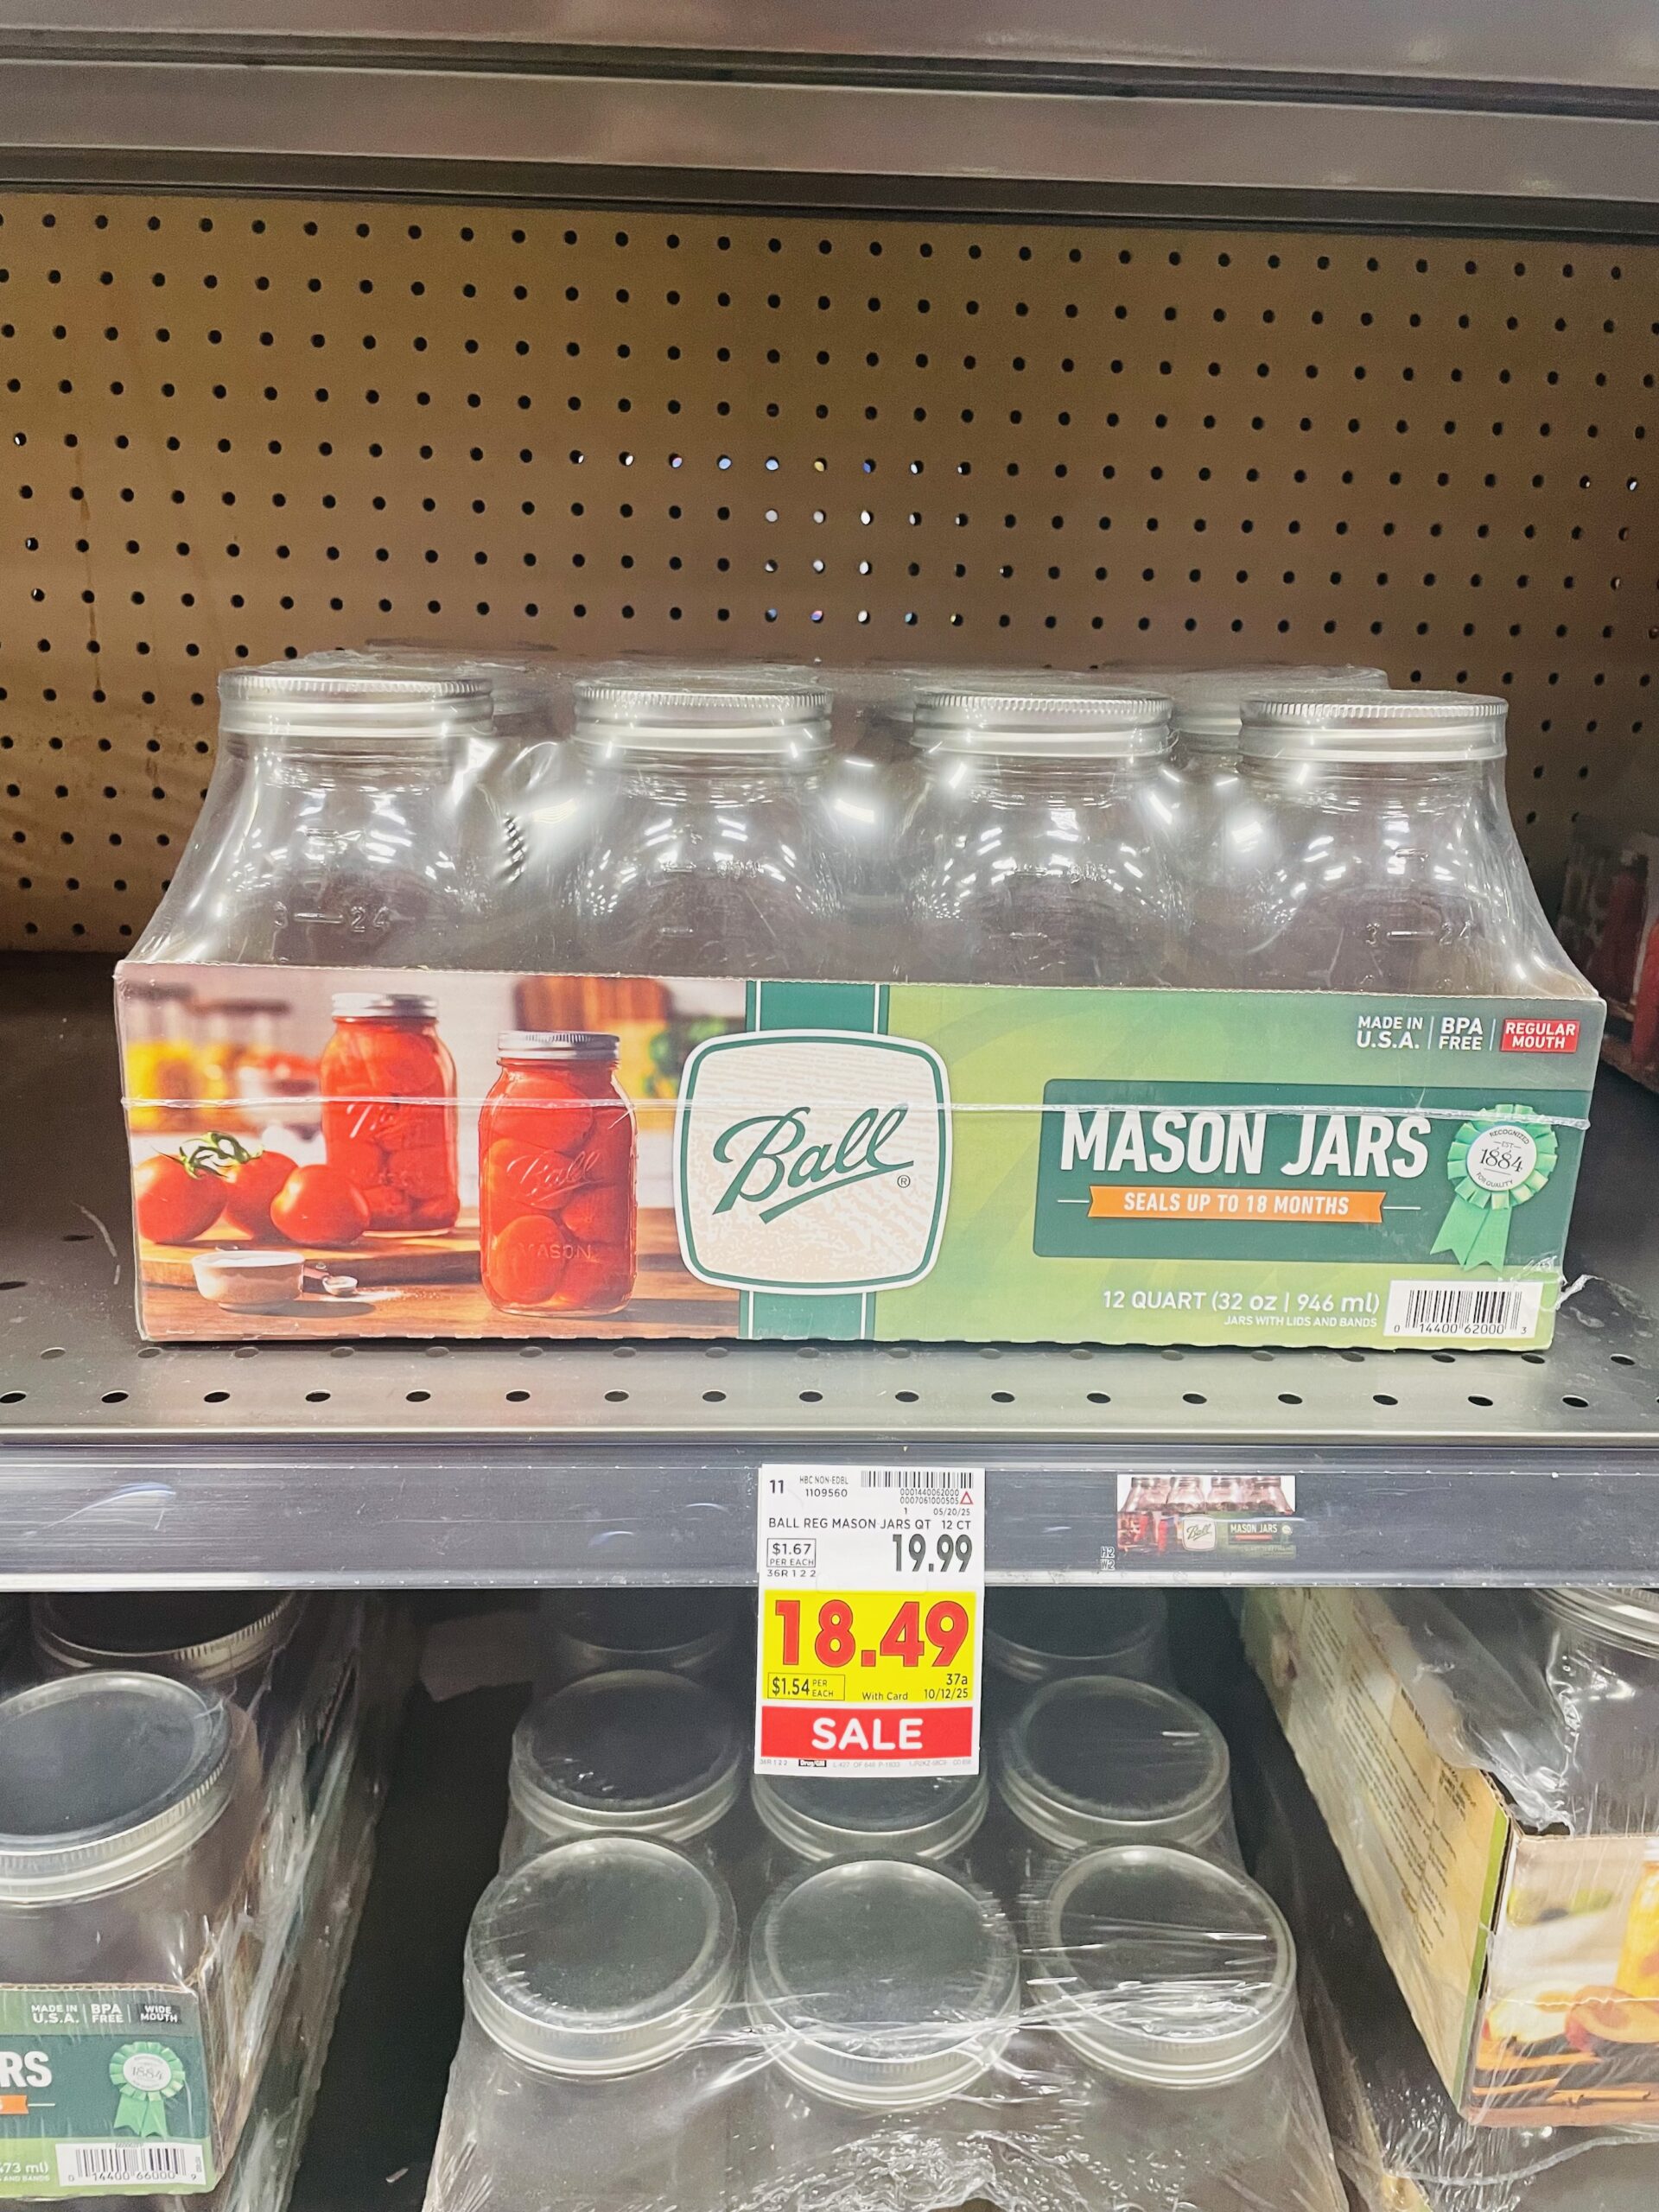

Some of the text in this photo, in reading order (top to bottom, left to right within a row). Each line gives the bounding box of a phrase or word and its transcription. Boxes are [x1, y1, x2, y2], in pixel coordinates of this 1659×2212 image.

[1357, 1016, 1423, 1030] MADE IN
[1440, 1017, 1484, 1035] BPA
[1505, 1021, 1576, 1036] REGULAR
[1357, 1031, 1420, 1049] U.S.A.
[1439, 1036, 1483, 1051] FREE
[1512, 1036, 1566, 1049] MOUTH
[1489, 1128, 1529, 1145] RECOGNIZED
[1060, 1109, 1432, 1179] MASON JARS
[712, 1103, 914, 1224] Ball
[1479, 1147, 1523, 1173] 1884
[1476, 1172, 1513, 1188] FOR QUALITY
[1123, 1192, 1350, 1216] SEALS UP TO 18 MONTHS
[1103, 1290, 1125, 1309] 12
[1132, 1291, 1207, 1311] QUART
[1211, 1290, 1243, 1313] (32
[1249, 1296, 1277, 1312] oz
[1298, 1294, 1334, 1313] 946
[1341, 1293, 1380, 1314] ml)
[1224, 1315, 1377, 1328] JARS WITH LIDS AND BANDS
[1394, 1325, 1401, 1333] 0
[1420, 1324, 1458, 1333] 14400
[1464, 1325, 1504, 1335] 62000
[799, 1475, 813, 1484] HBC
[769, 1479, 784, 1494] 11
[805, 1488, 848, 1497] 1109560
[933, 1508, 970, 1516] 05/20/25
[768, 1517, 971, 1530] BALL REG MASON JARS QT 12 CT
[1230, 1523, 1278, 1533] MASON JARS
[772, 1542, 811, 1556] $1.67
[893, 1534, 973, 1573] 19.99
[790, 1558, 814, 1567] EACH
[767, 1569, 788, 1578] 36R
[800, 1569, 806, 1578] 2
[810, 1569, 816, 1578] 2
[775, 1599, 969, 1668] 18.49
[772, 1676, 810, 1696] $1.54
[946, 1673, 968, 1686] 37a
[861, 1691, 908, 1700] With Card
[925, 1688, 969, 1700] 10/12/25
[811, 1717, 924, 1751] SALE
[31, 2004, 78, 2012] MADE IN
[91, 2003, 122, 2014] BPA
[144, 2005, 172, 2014] WIDE
[32, 2012, 79, 2024] U.S.A.
[92, 2013, 124, 2024] FREE
[140, 2012, 178, 2023] MOUTH
[25, 2161, 49, 2174] ml)
[92, 2172, 130, 2182] 14400
[136, 2171, 175, 2181] 66000
